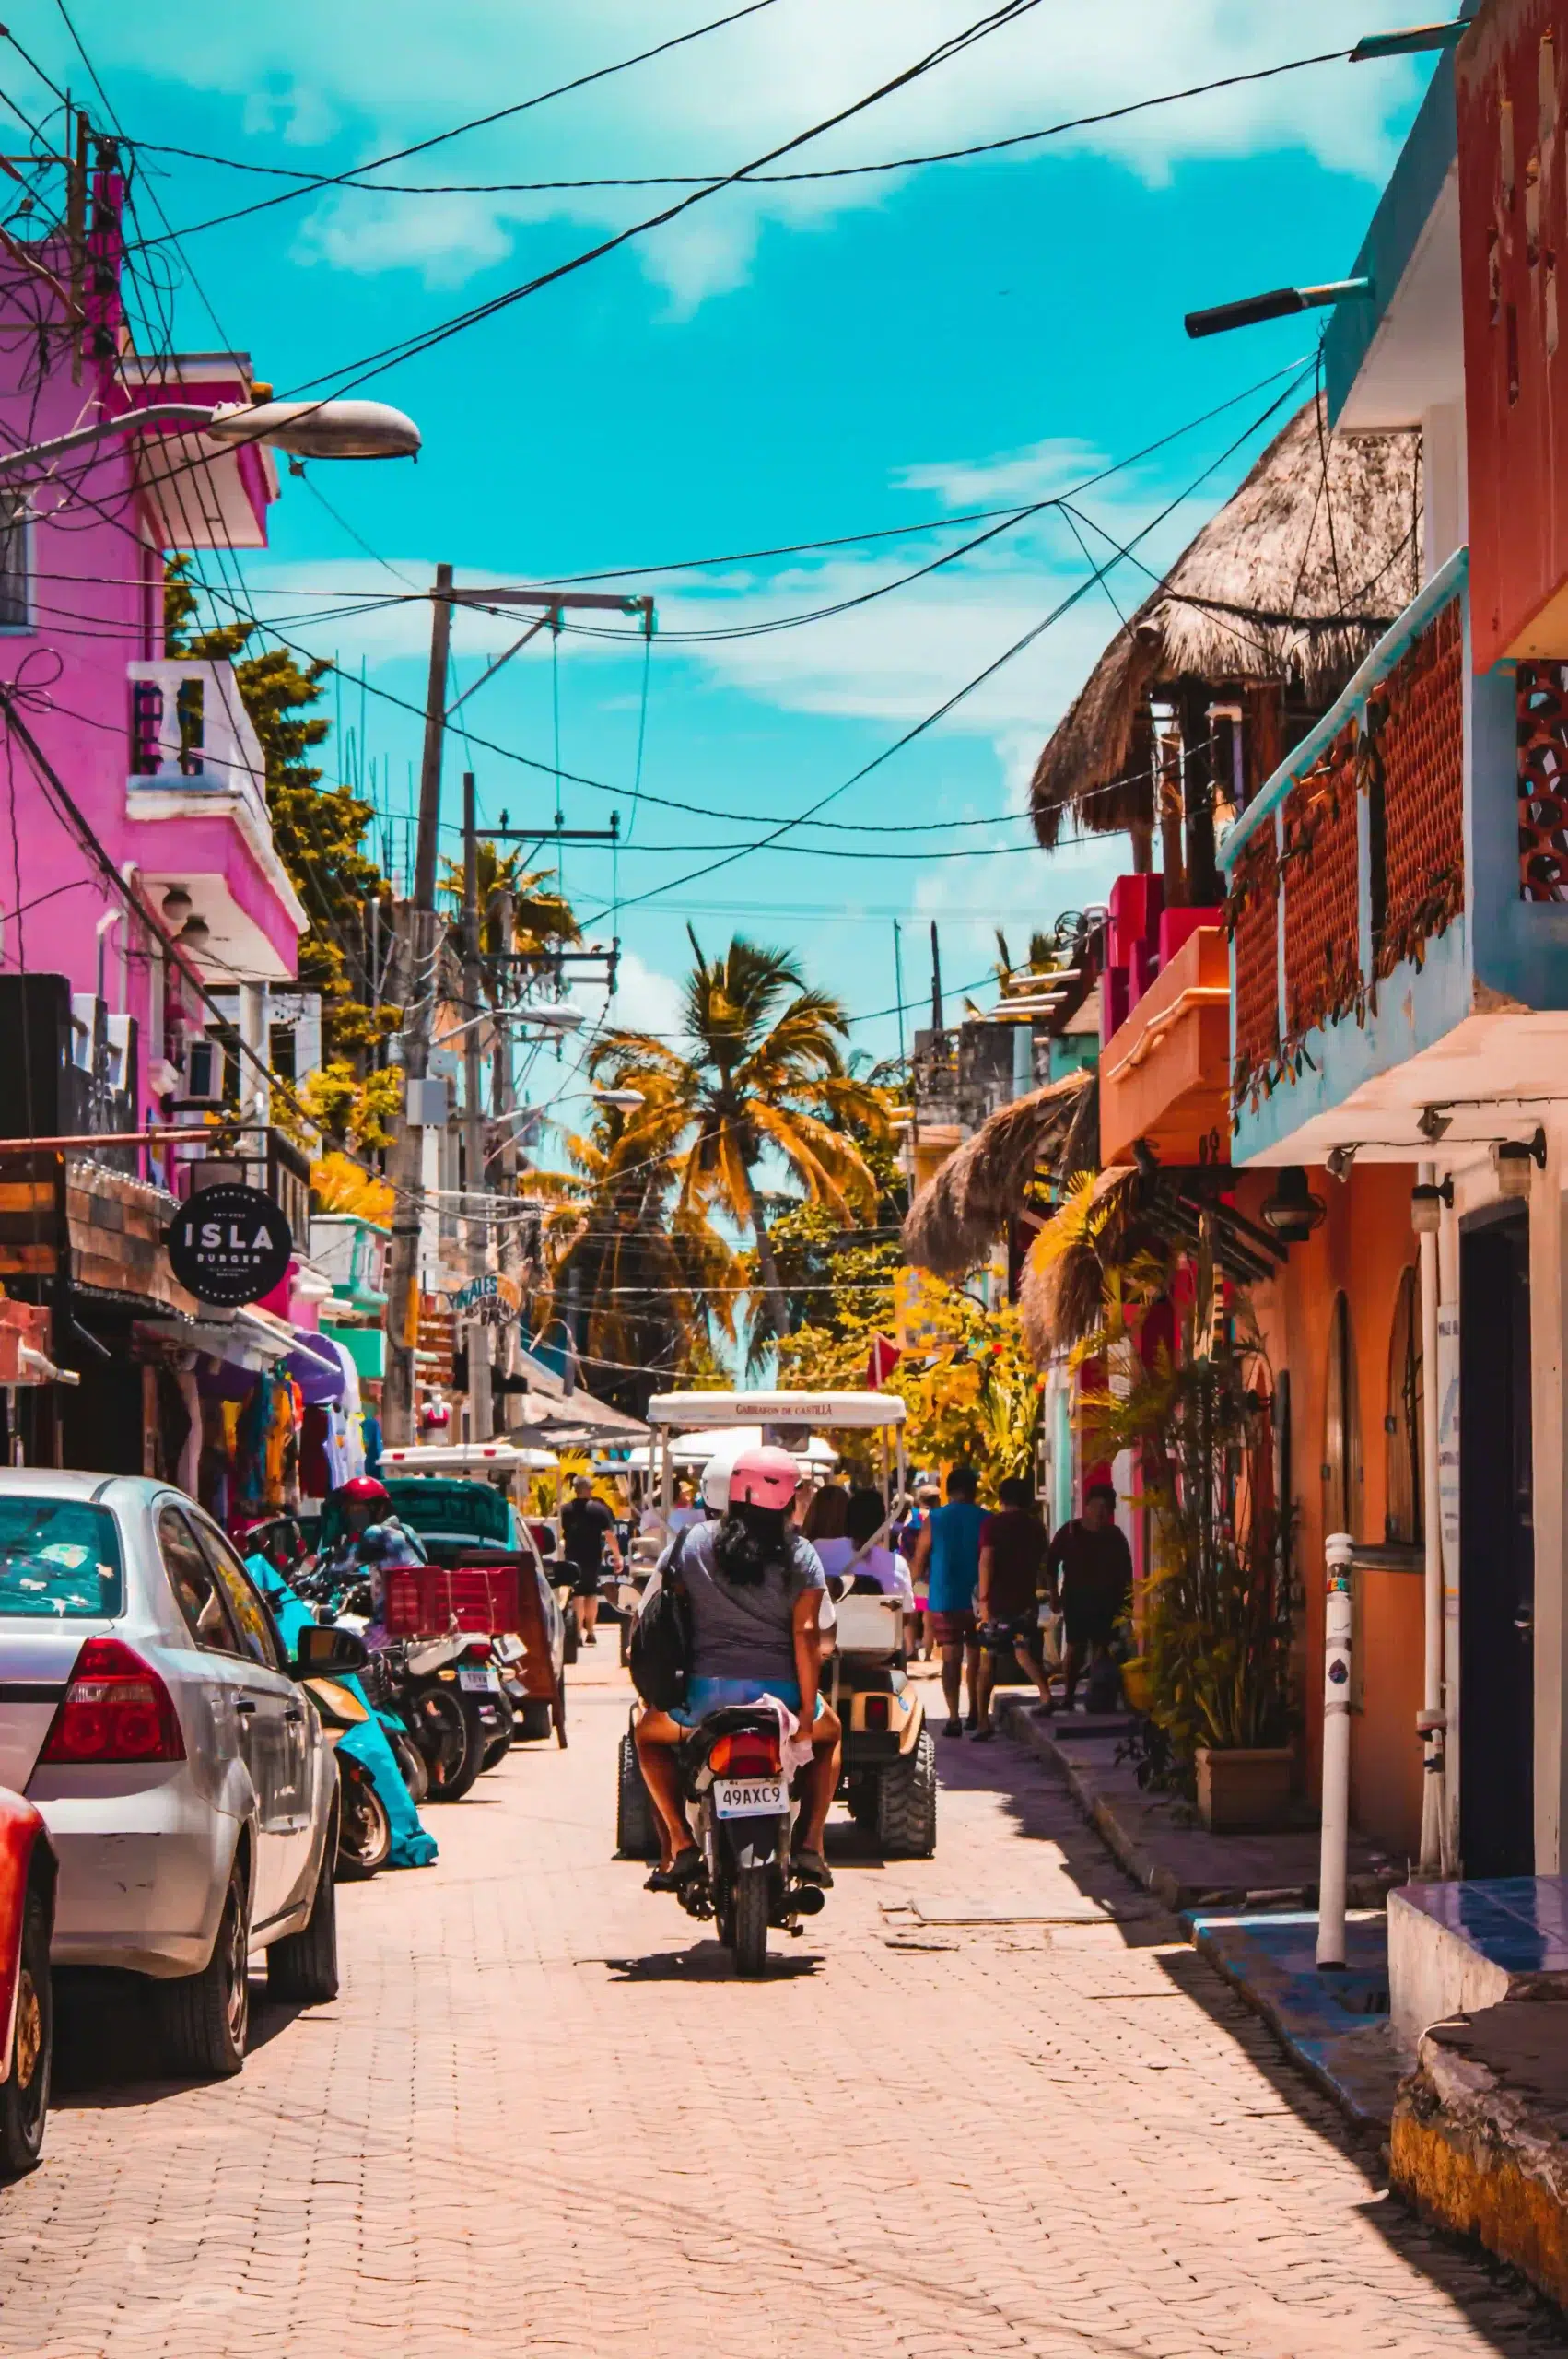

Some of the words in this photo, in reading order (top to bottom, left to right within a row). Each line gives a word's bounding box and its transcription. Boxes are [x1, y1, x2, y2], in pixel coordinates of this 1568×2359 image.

[184, 1223, 274, 1250] ISLA
[196, 1252, 261, 1264] BURGER
[794, 1403, 833, 1416] CASTILLA
[722, 1787, 781, 1806] 49AXC9
